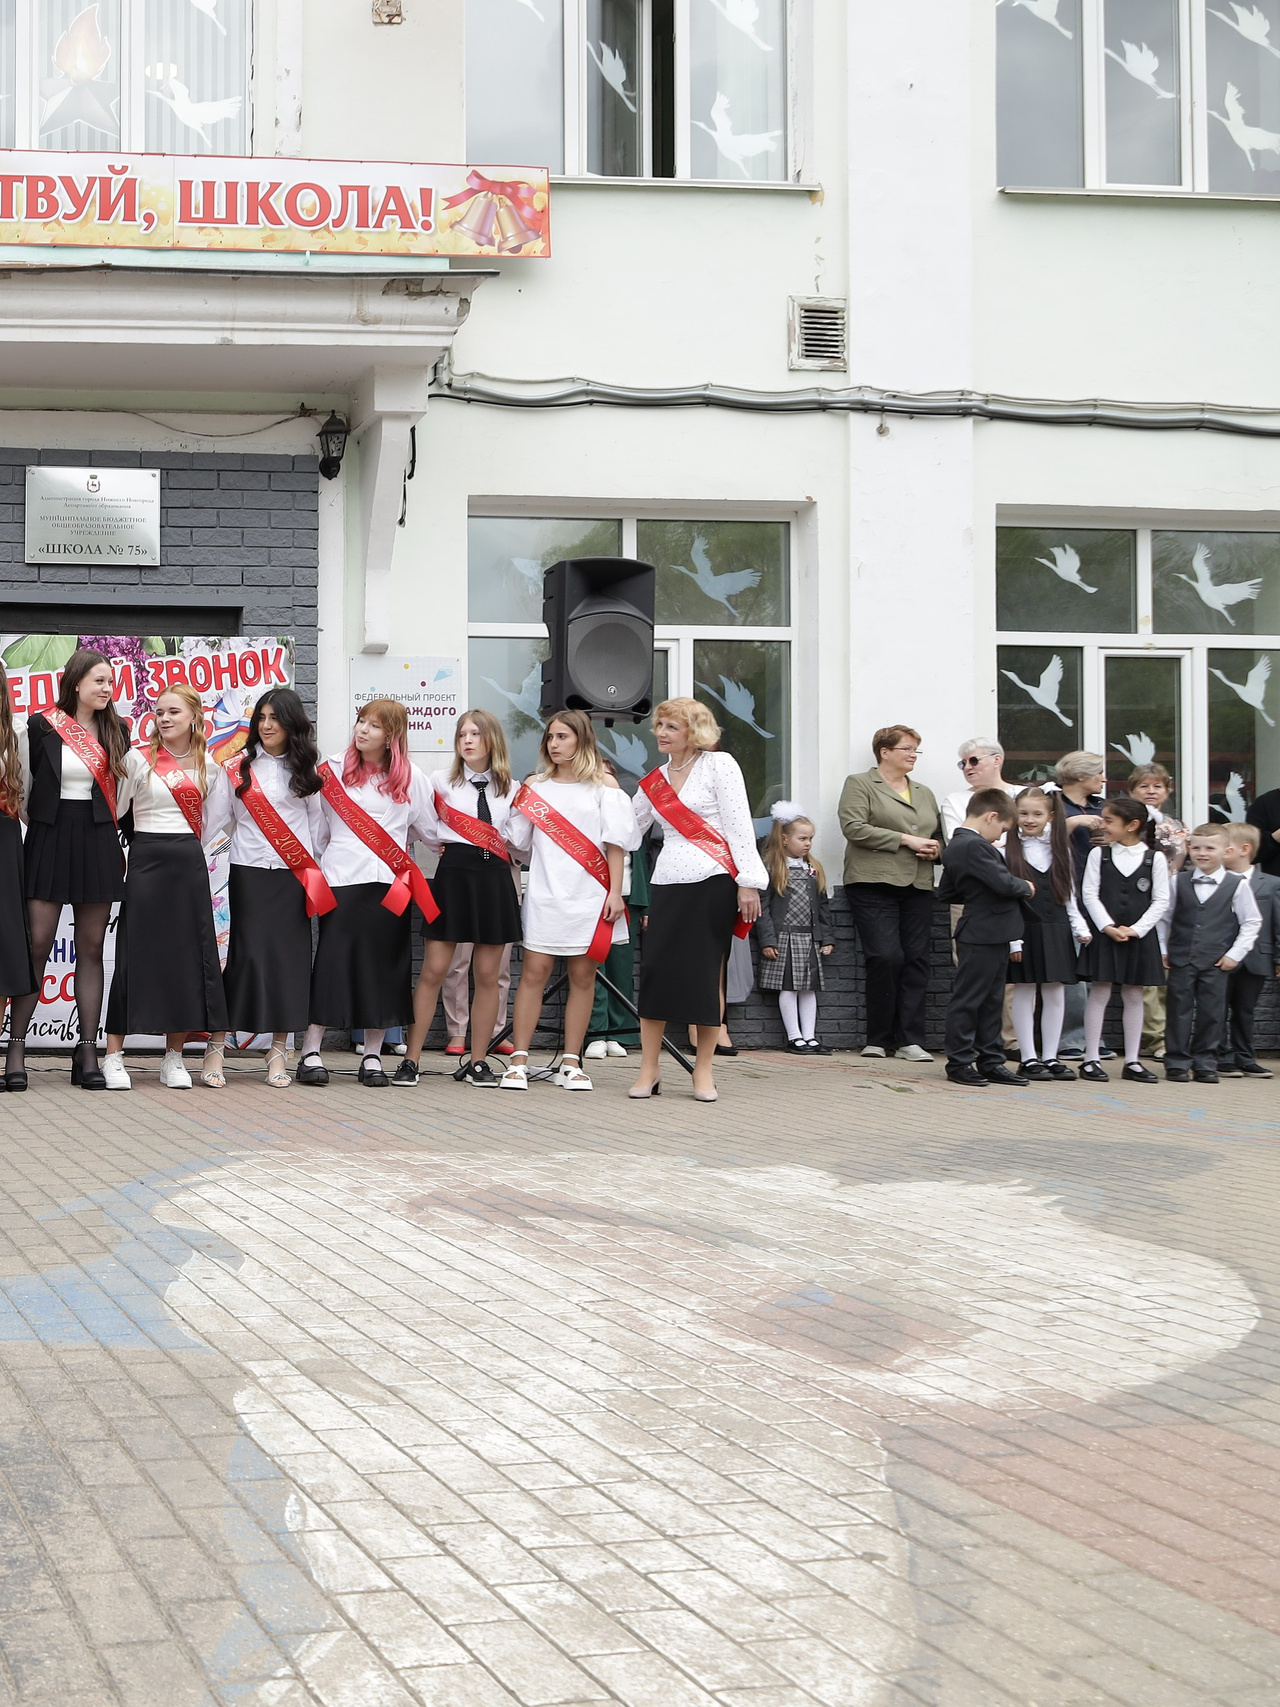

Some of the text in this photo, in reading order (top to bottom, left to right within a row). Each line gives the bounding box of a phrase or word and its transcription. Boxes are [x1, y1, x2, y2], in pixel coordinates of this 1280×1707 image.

[177, 179, 436, 233] ШКОЛА!
[38, 543, 148, 556] «ШКОЛА № 75»
[146, 647, 287, 698] ЗВОНОК
[406, 706, 458, 717] АЖДОГО
[422, 693, 457, 702] ПРОЕКТ
[329, 786, 382, 847] Выпускница
[527, 800, 589, 858] Выпускница
[273, 832, 308, 866] 2025
